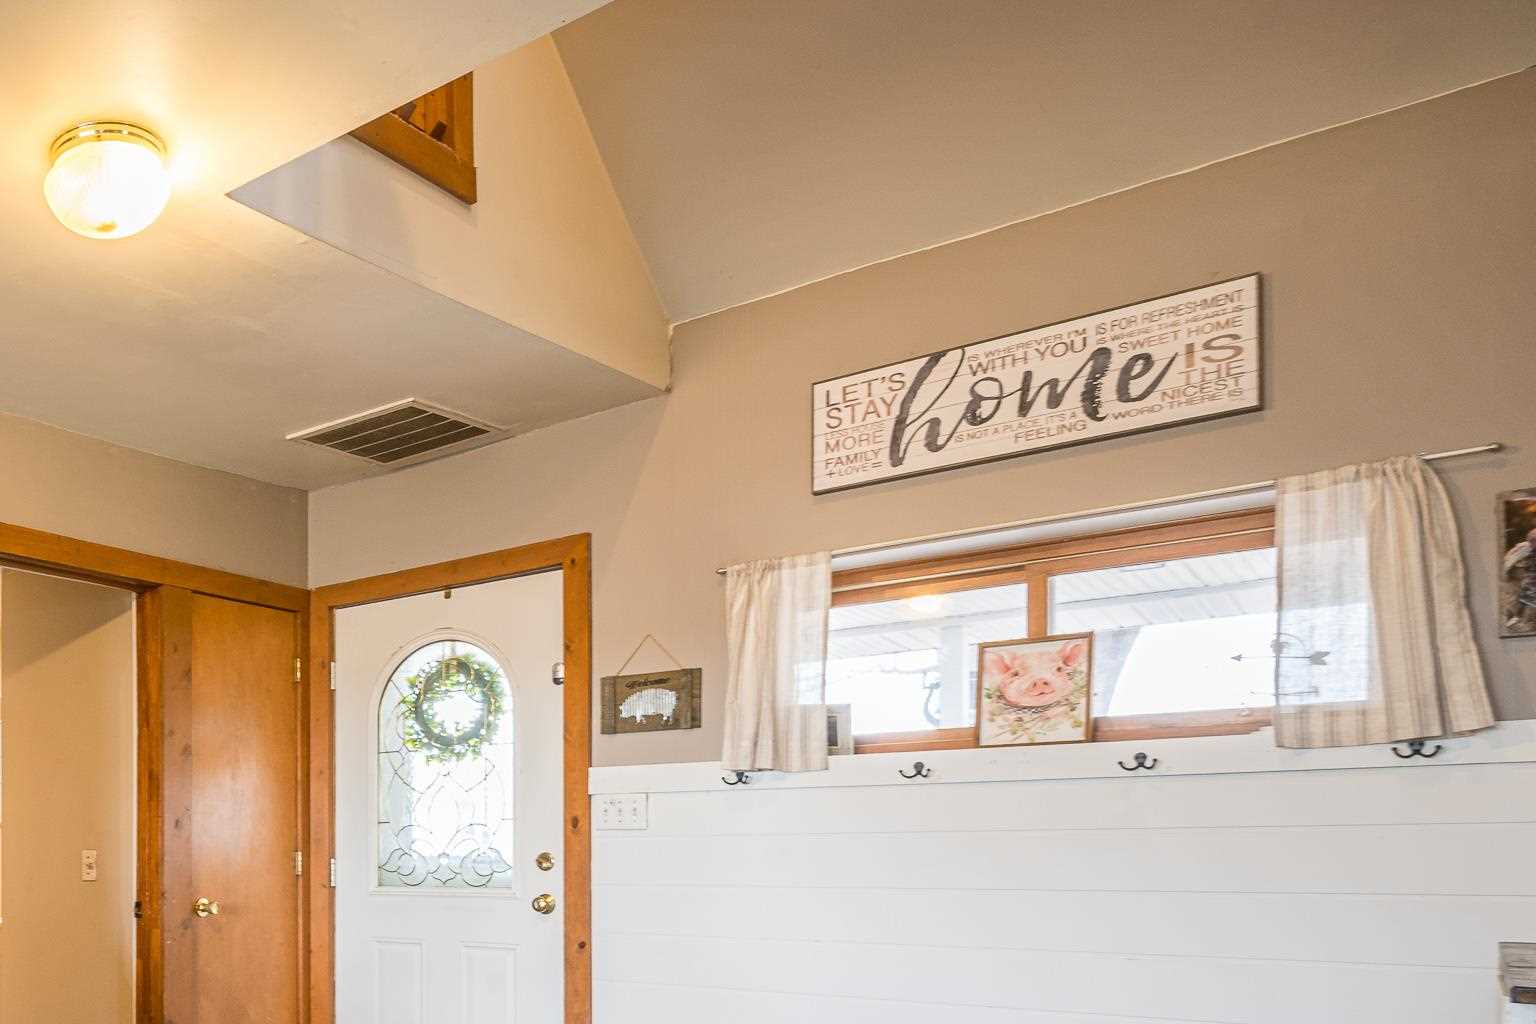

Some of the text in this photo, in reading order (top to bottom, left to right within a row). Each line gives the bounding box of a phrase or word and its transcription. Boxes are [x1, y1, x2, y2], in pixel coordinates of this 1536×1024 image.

[1096, 288, 1245, 336] IS FOR REFRESHMENT
[984, 332, 1064, 359] WHEREVER
[1118, 315, 1244, 353] SWEET HOME
[968, 336, 1087, 377] WITH YOU
[1184, 333, 1244, 369] IS
[1161, 375, 1245, 402] NICEST
[1177, 359, 1245, 386] THE
[826, 372, 906, 407] LET'S
[825, 393, 899, 429] STAY
[890, 347, 1178, 468] home
[1112, 404, 1163, 421] WORD
[1167, 391, 1224, 410] THERE
[825, 431, 885, 455] MORE
[1014, 419, 1089, 444] FEELING
[825, 448, 882, 471] FAMILY
